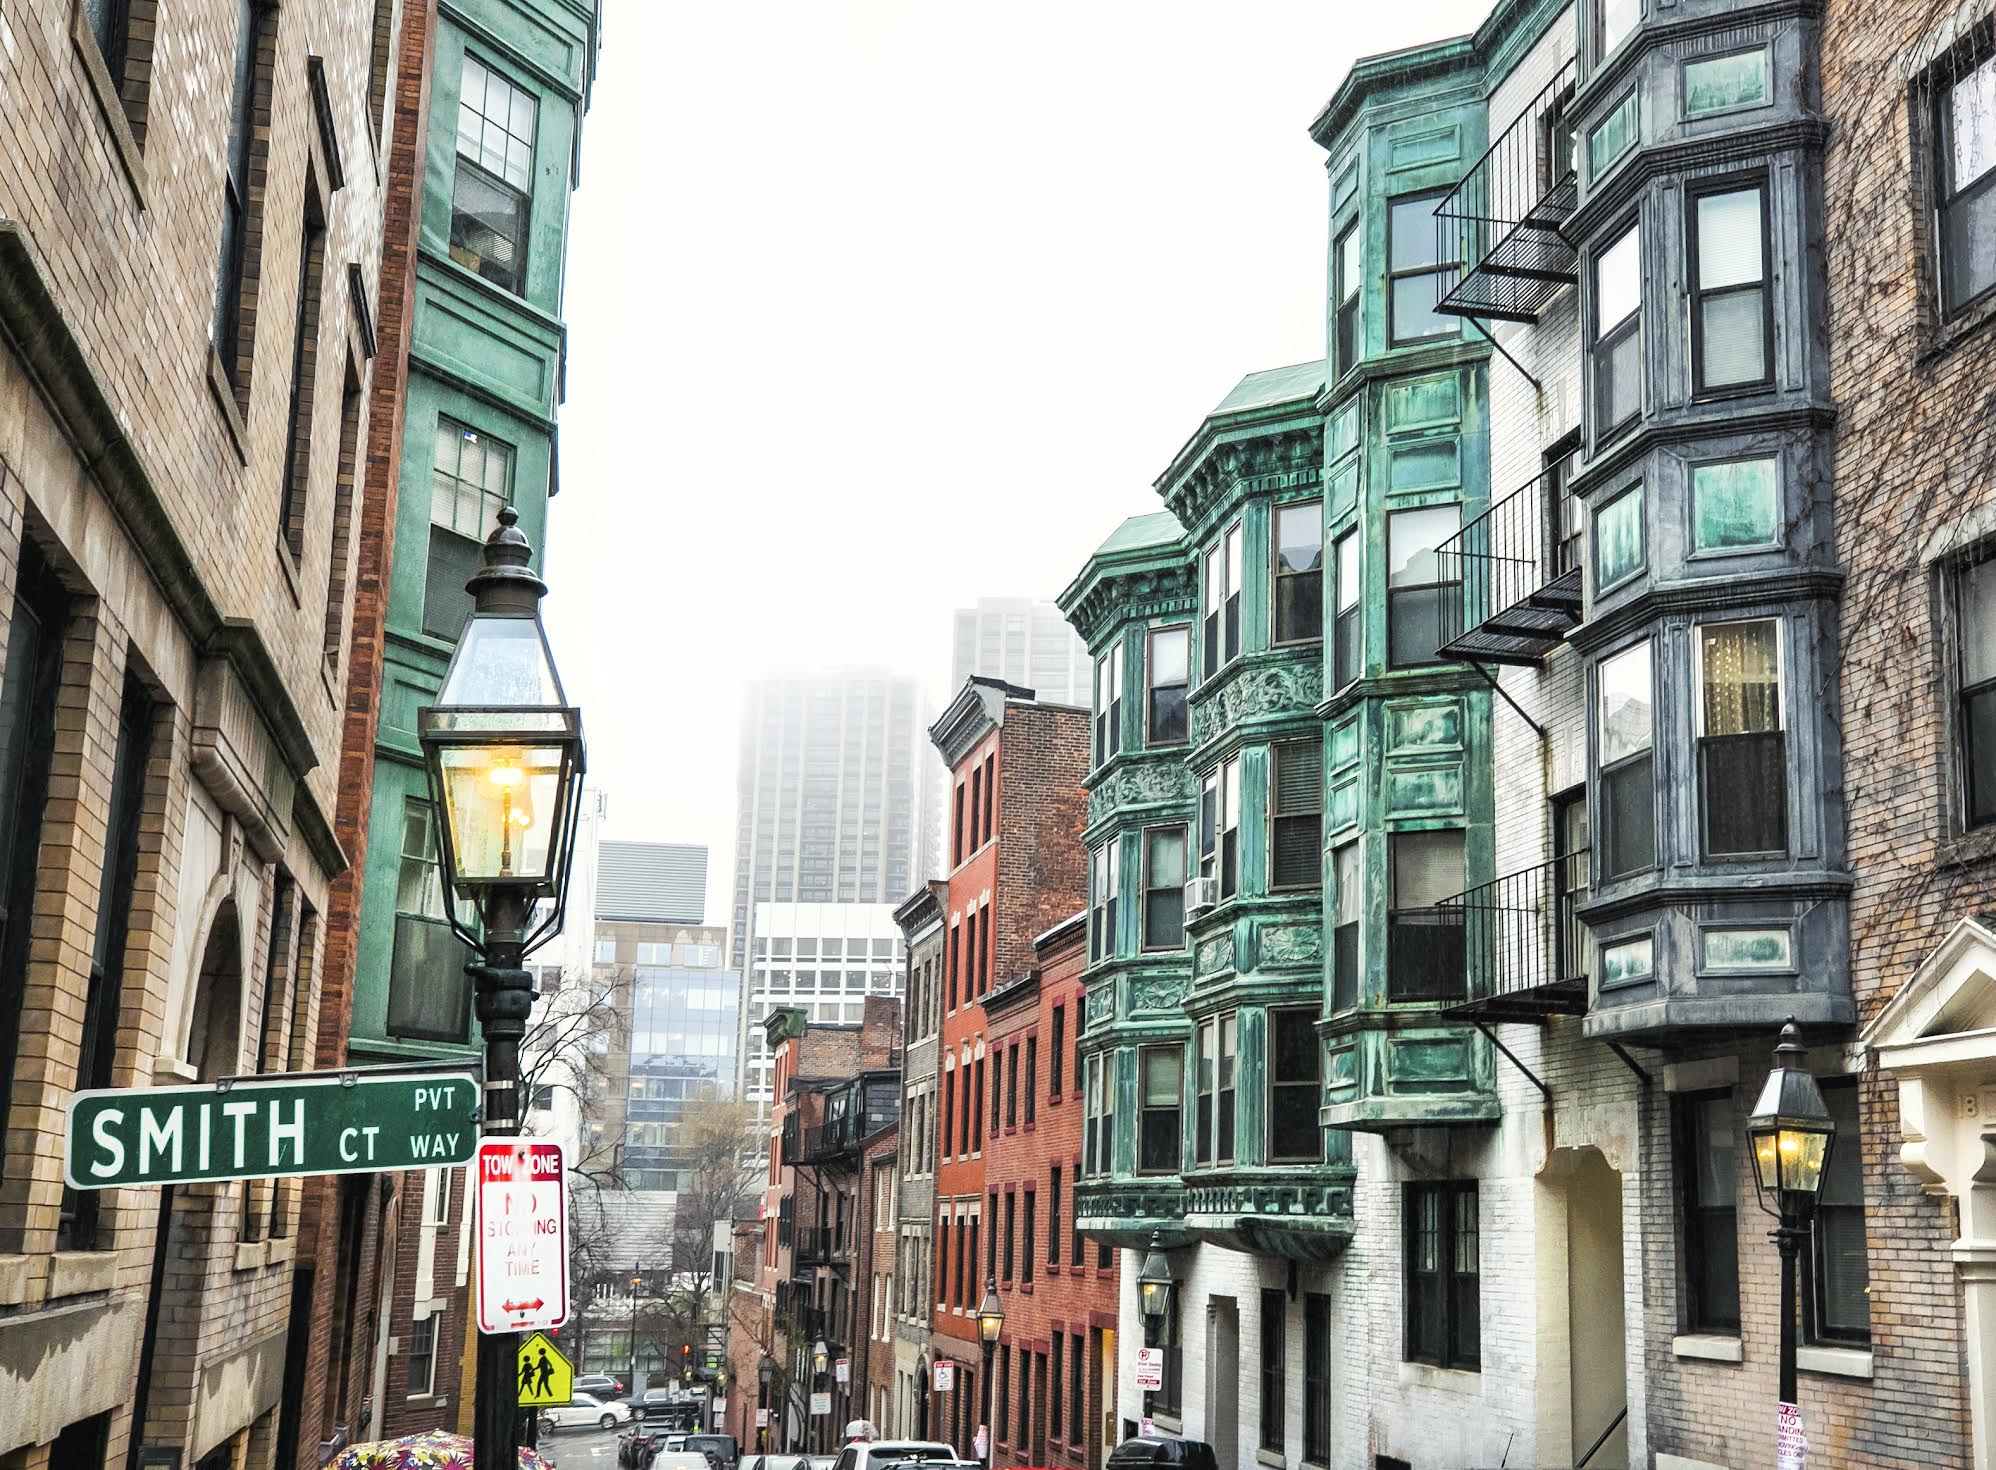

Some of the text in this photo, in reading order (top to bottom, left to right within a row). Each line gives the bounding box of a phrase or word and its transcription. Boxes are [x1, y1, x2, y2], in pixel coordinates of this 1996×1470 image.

[415, 1087, 455, 1111] PVT
[90, 1099, 379, 1178] SMITH CT
[410, 1133, 459, 1158] WAY
[482, 1154, 514, 1176] TOW
[504, 1259, 540, 1277] TIME
[1780, 1415, 1796, 1426] NO
